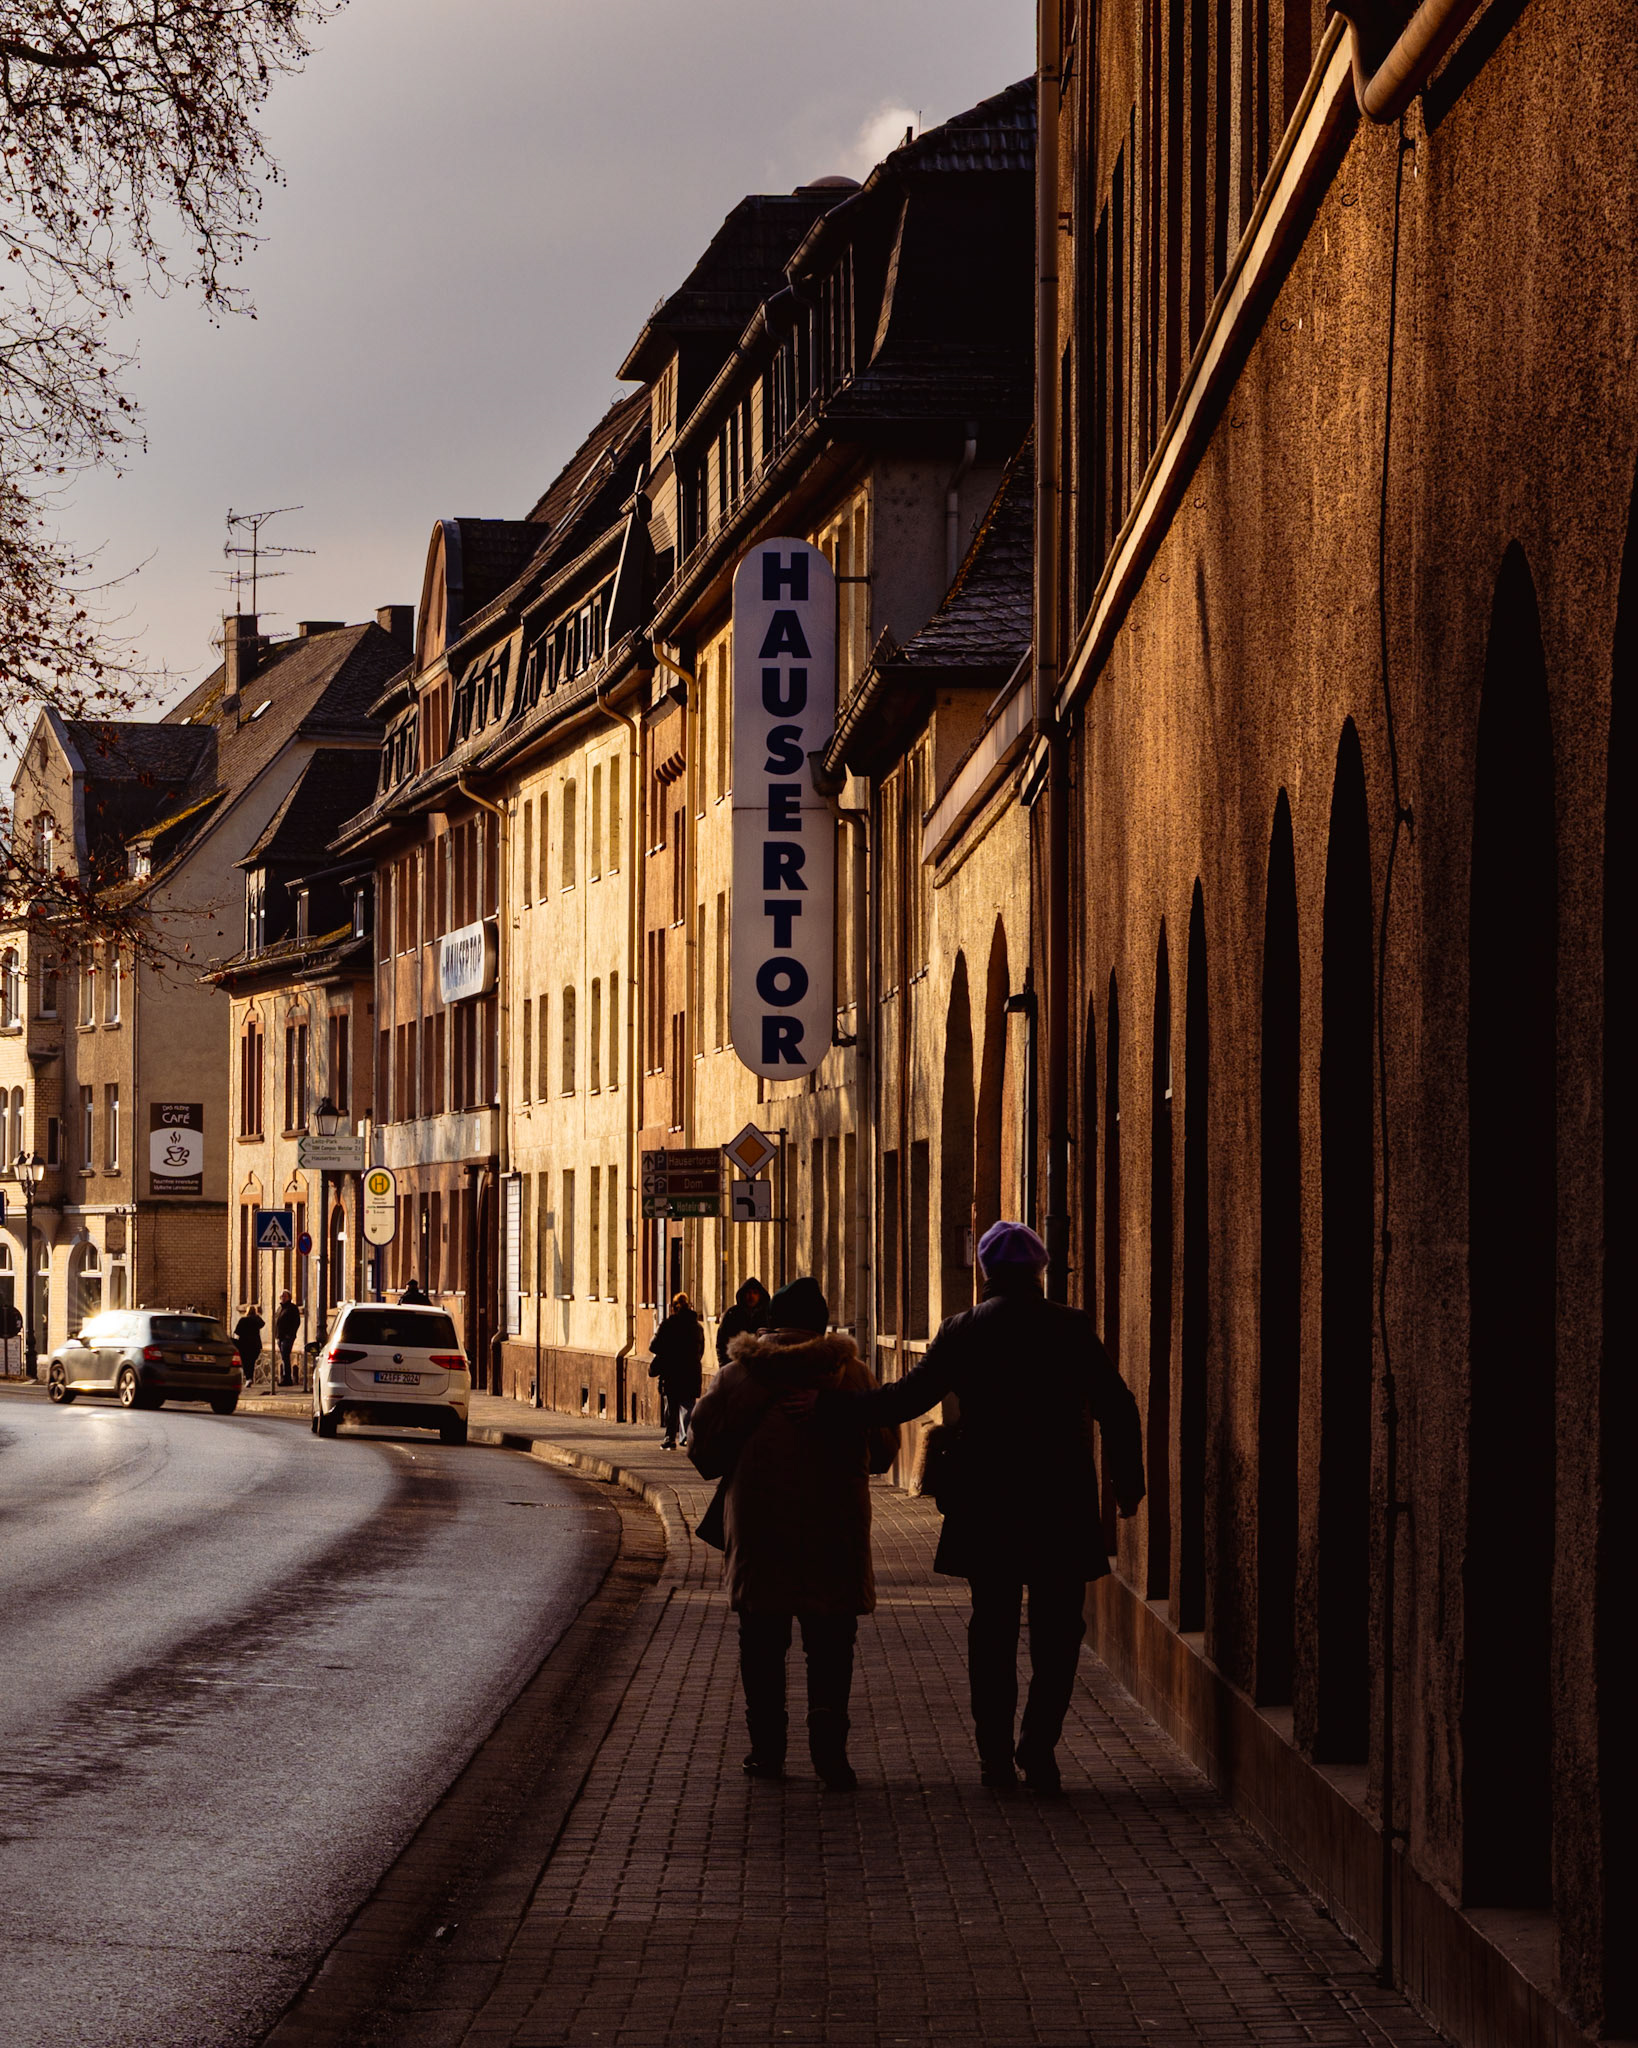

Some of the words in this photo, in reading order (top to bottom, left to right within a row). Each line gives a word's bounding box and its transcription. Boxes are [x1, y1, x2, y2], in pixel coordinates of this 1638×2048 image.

[755, 552, 811, 1065] HAUSERTOR
[374, 1177, 384, 1191] H
[684, 1178, 703, 1190] Dom
